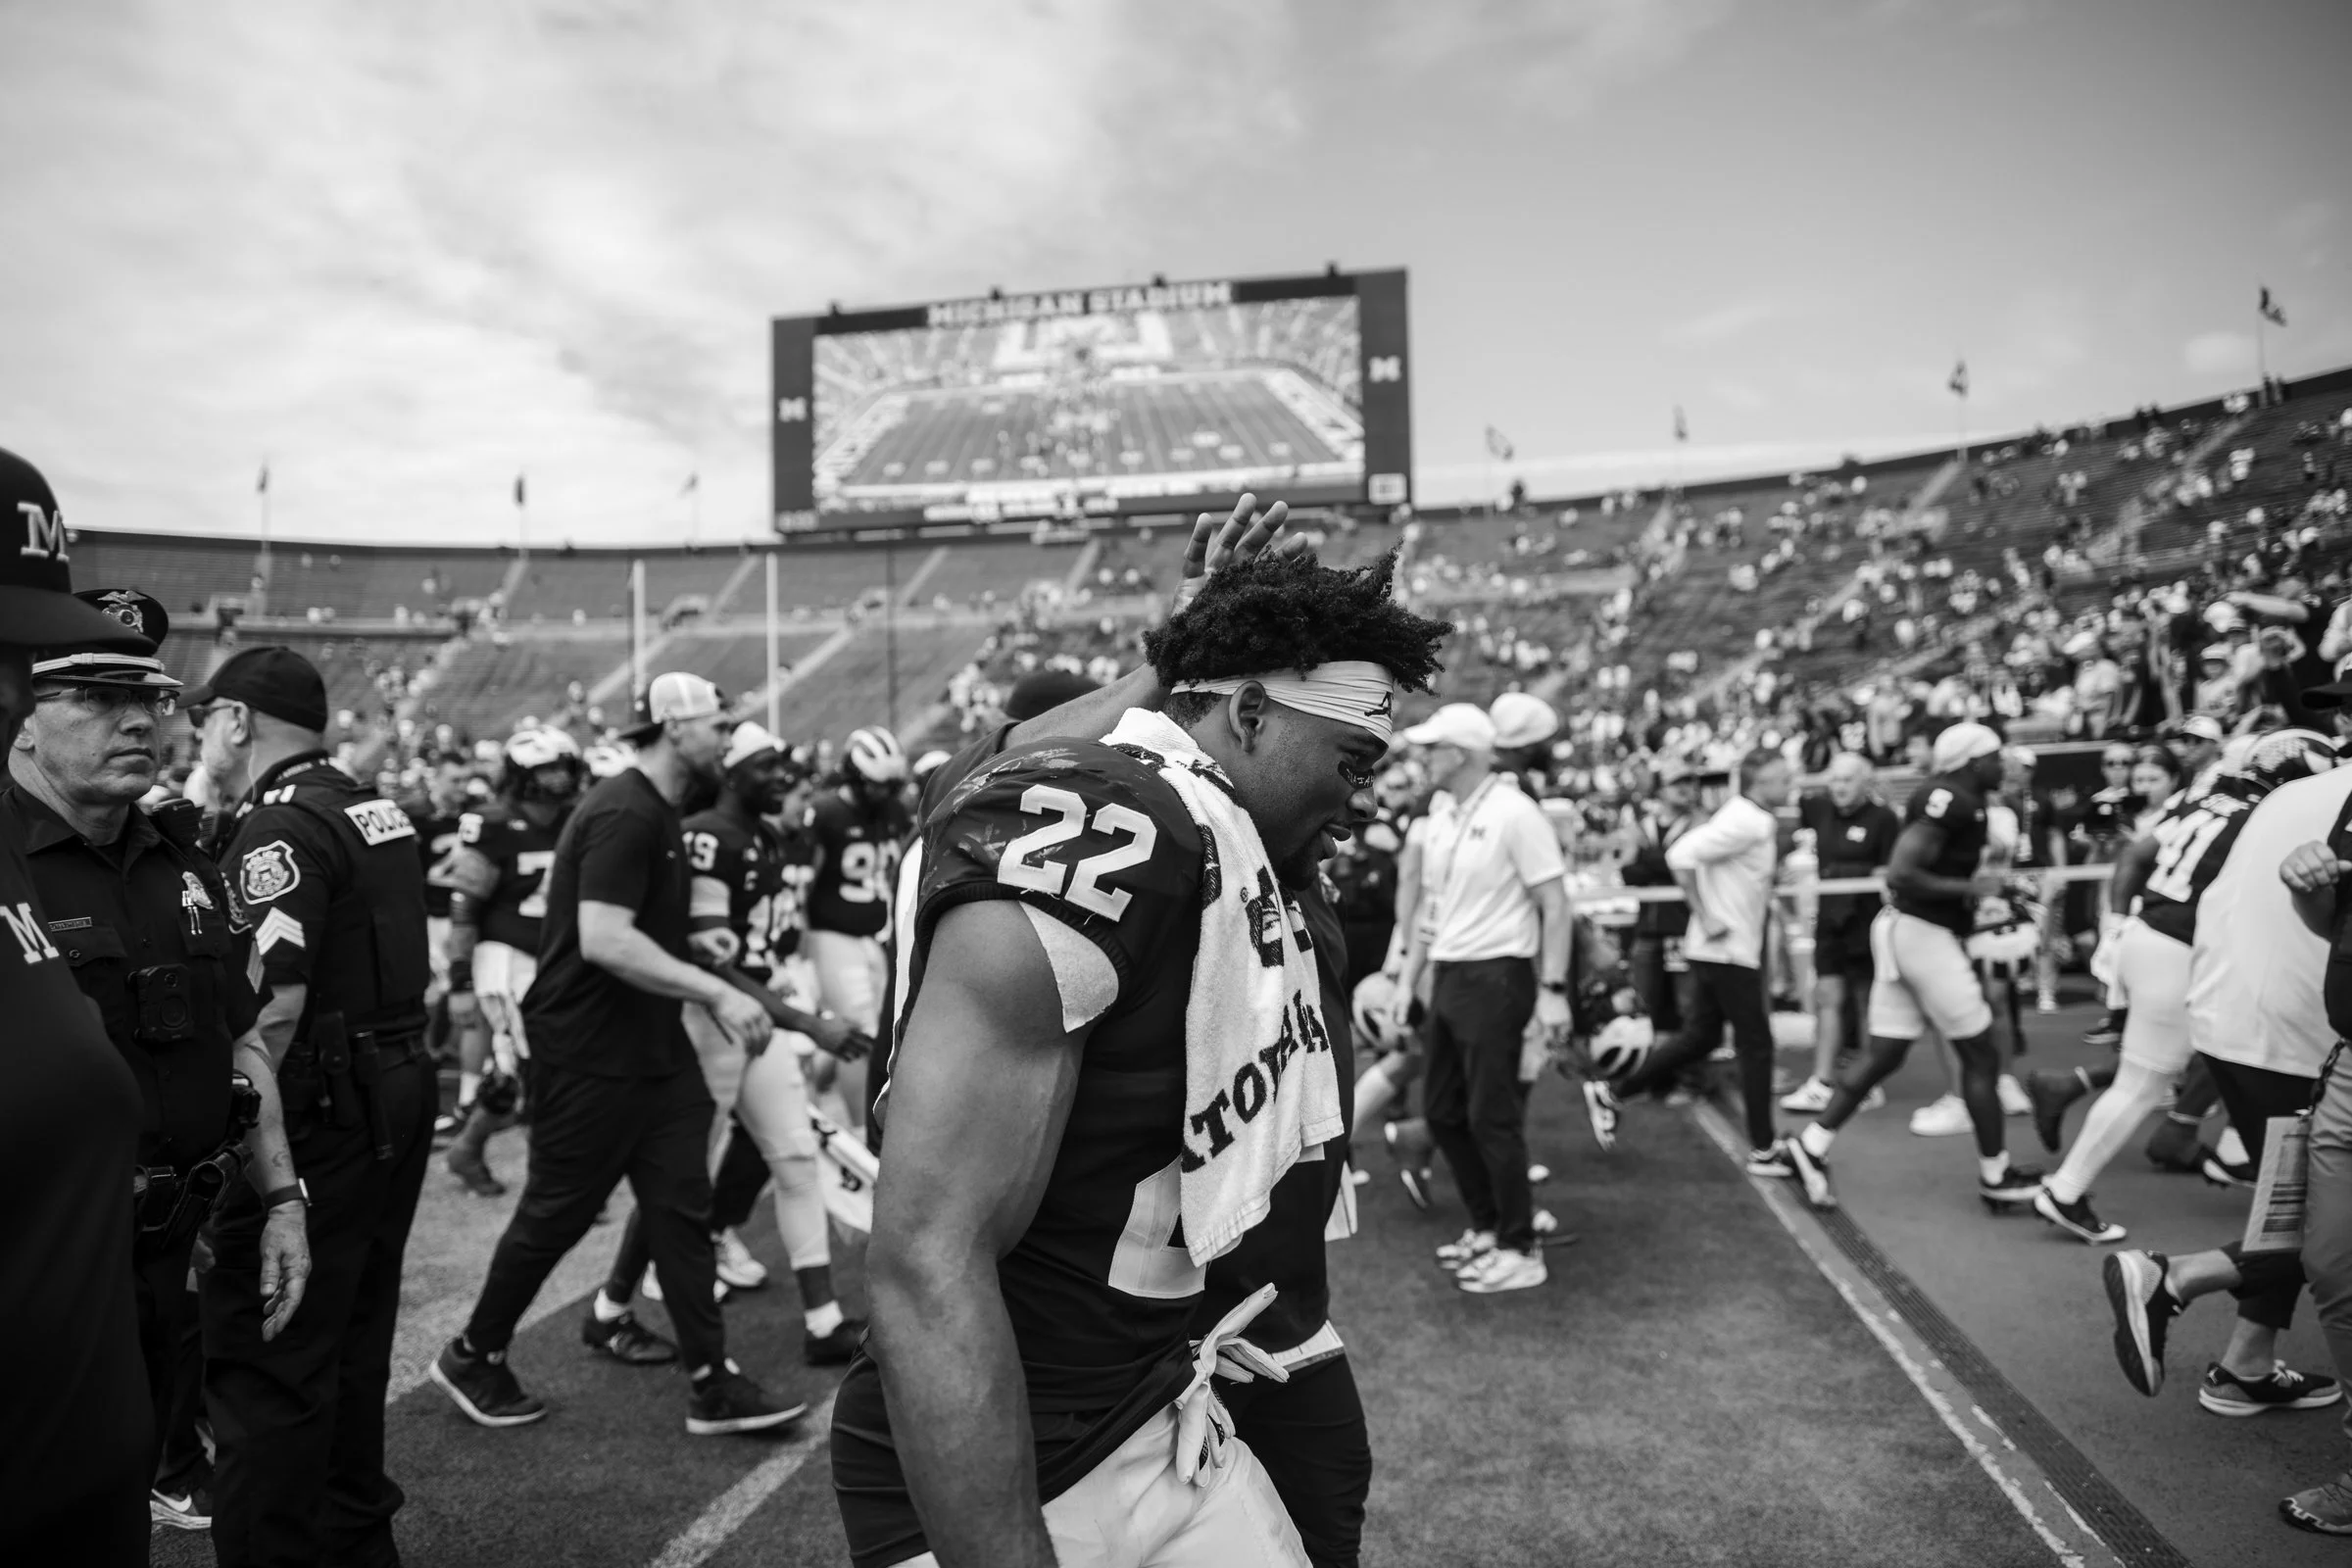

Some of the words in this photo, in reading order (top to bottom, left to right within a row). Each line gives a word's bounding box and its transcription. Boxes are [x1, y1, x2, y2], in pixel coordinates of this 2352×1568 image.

[17, 501, 70, 562] M
[998, 784, 1157, 922] 22
[0, 902, 59, 964] M
